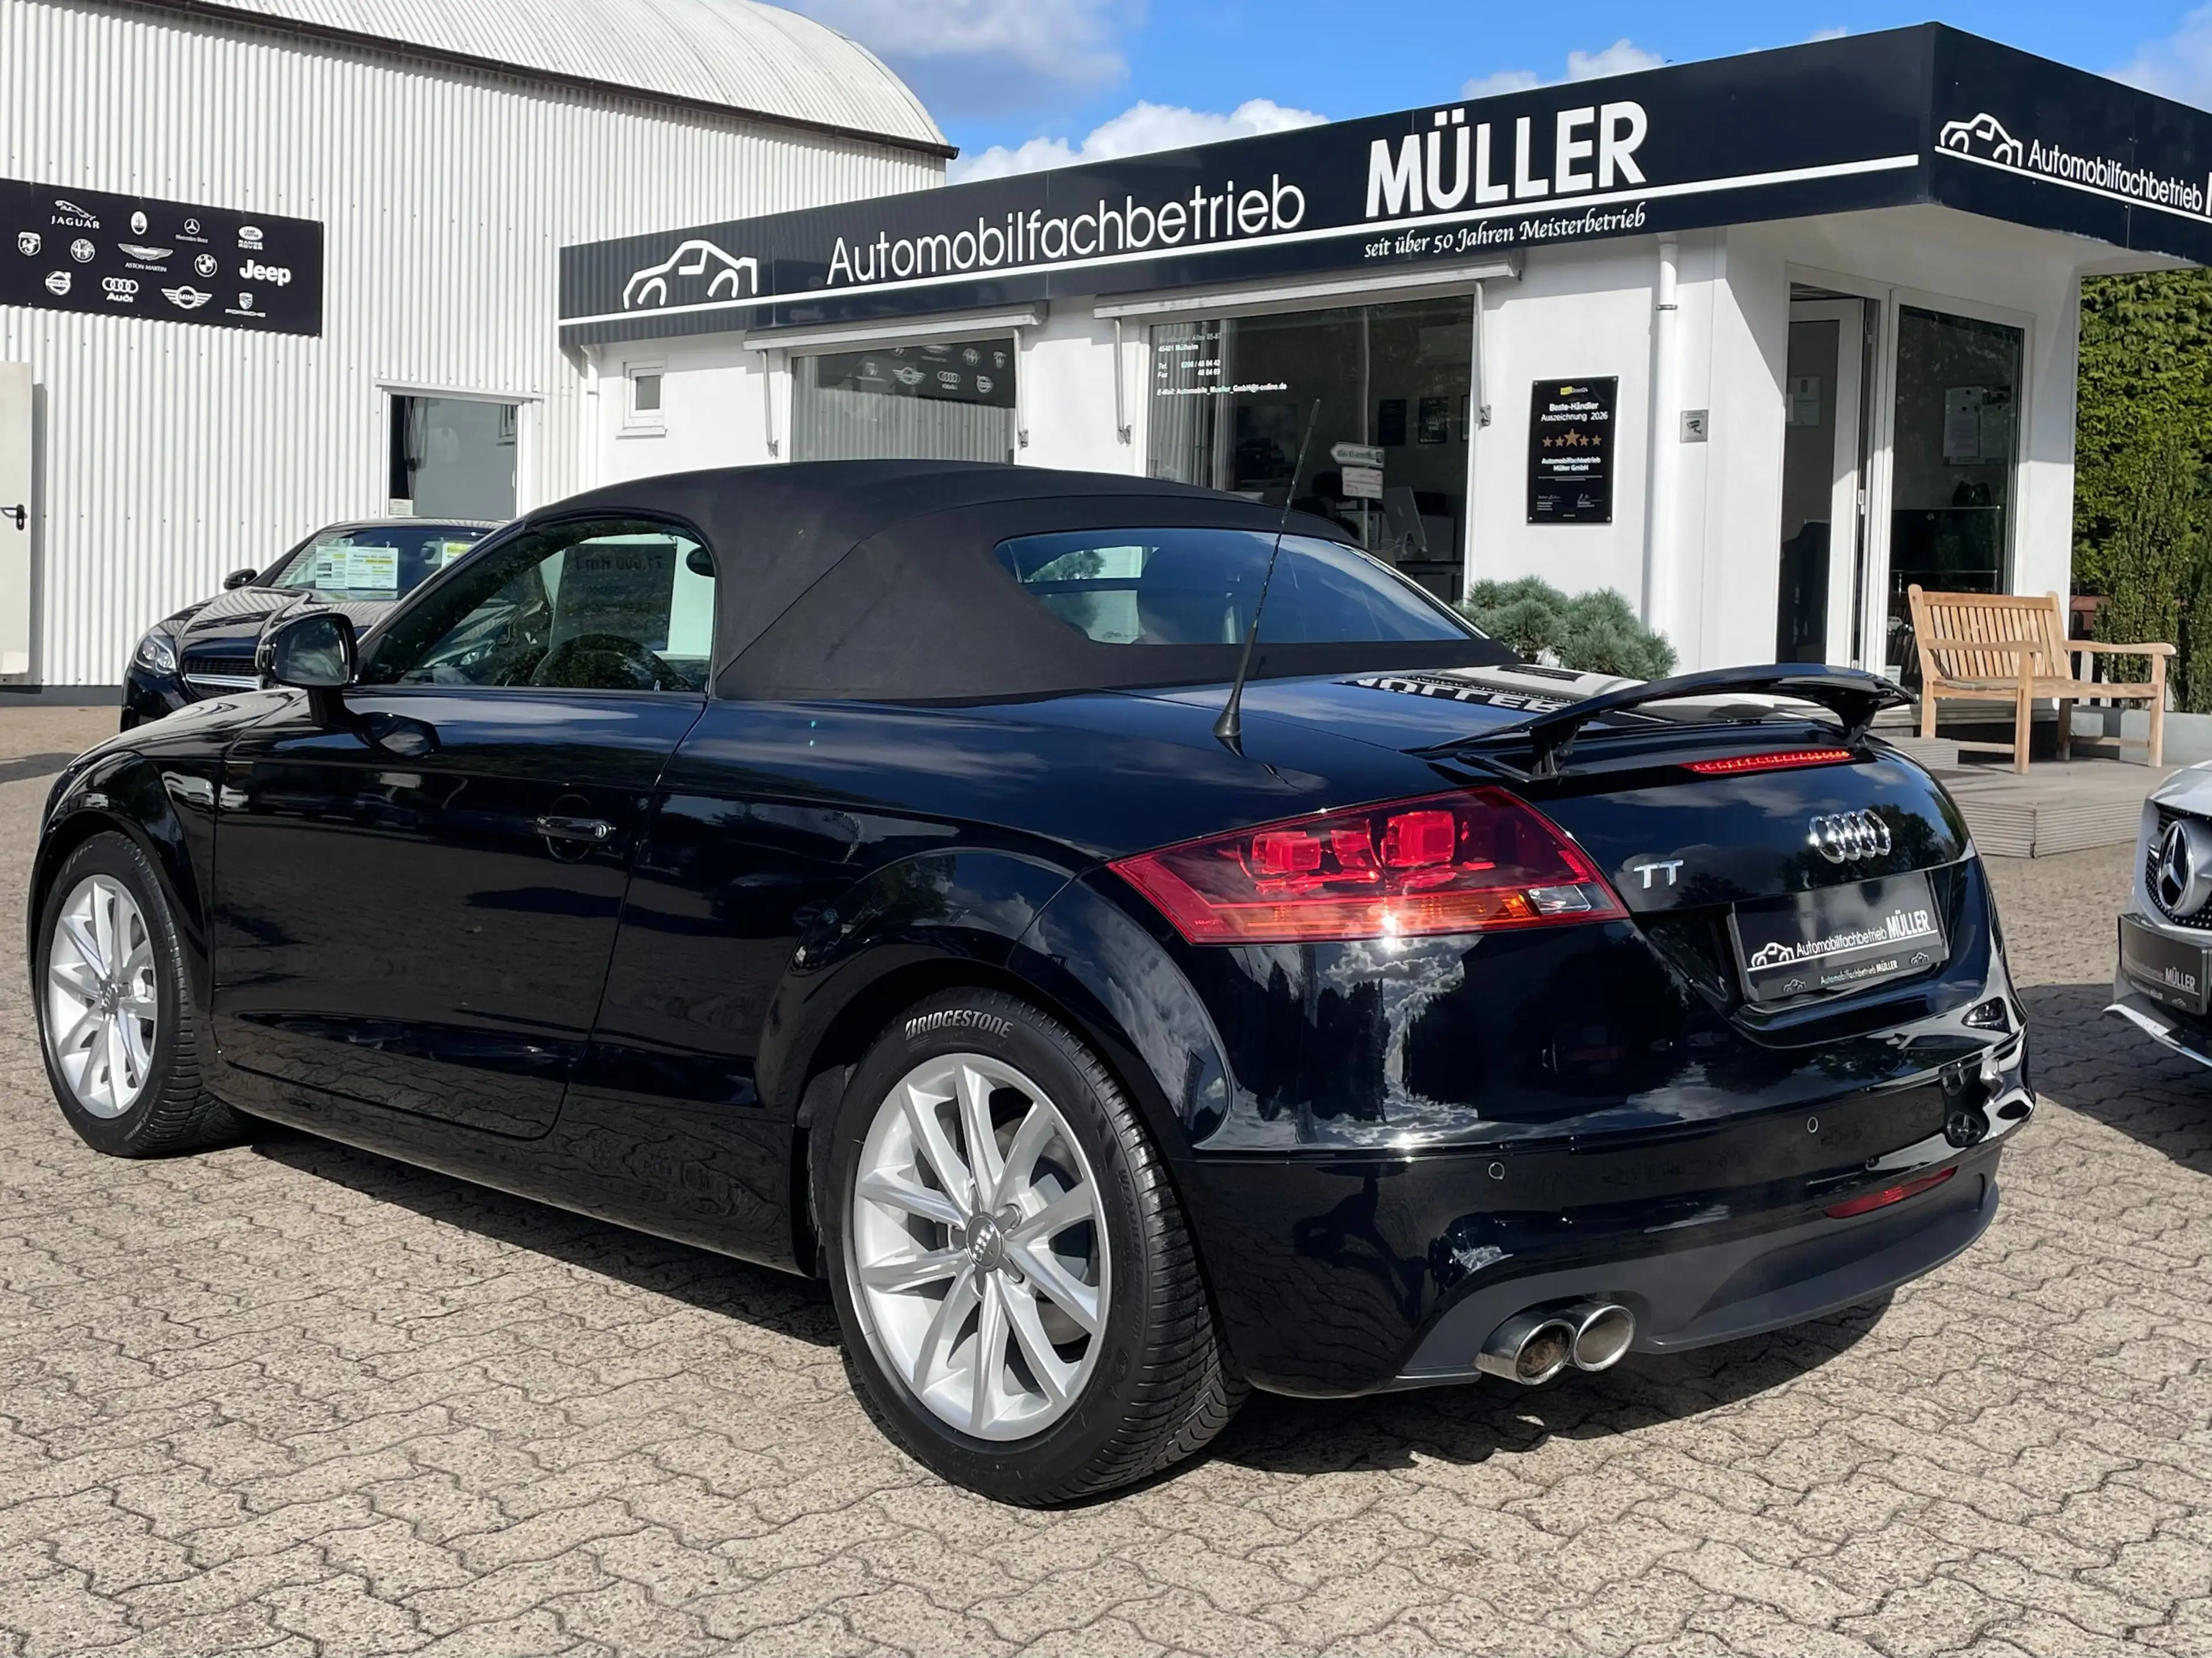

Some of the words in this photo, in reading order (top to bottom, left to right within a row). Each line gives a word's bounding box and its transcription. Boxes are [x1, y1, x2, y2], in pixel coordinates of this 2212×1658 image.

[1365, 100, 1647, 218] MÜLLER
[2028, 139, 2203, 211] Automobilfachbetrieb
[51, 215, 100, 229] JAGUAR
[826, 173, 1305, 286] Automobilfachbetrieb
[1363, 236, 1392, 258] seit
[1394, 230, 1430, 255] über
[1433, 235, 1453, 253] 50
[1455, 221, 1515, 252] Jahren
[1518, 201, 1647, 240] Meisterbetrieb
[124, 262, 145, 271] ASTON
[145, 264, 168, 272] MARTIN
[239, 259, 291, 286] Jeep
[106, 292, 134, 303] Audi
[179, 293, 195, 301] MINI
[1548, 401, 1600, 412] Beste-Händler
[1540, 413, 1588, 422] Auszeichnung
[1541, 456, 1601, 465] Automobilfachbetrieb
[1570, 464, 1589, 472] GmbH
[1634, 859, 1684, 890] TT
[1796, 926, 1887, 957] Automobilfachbetrieb
[1885, 909, 1931, 940] MÜLLER
[1876, 959, 1898, 973] MÜLLER
[2165, 966, 2196, 992] MÜLLER
[904, 1009, 1014, 1041] BRIDGESTONE
